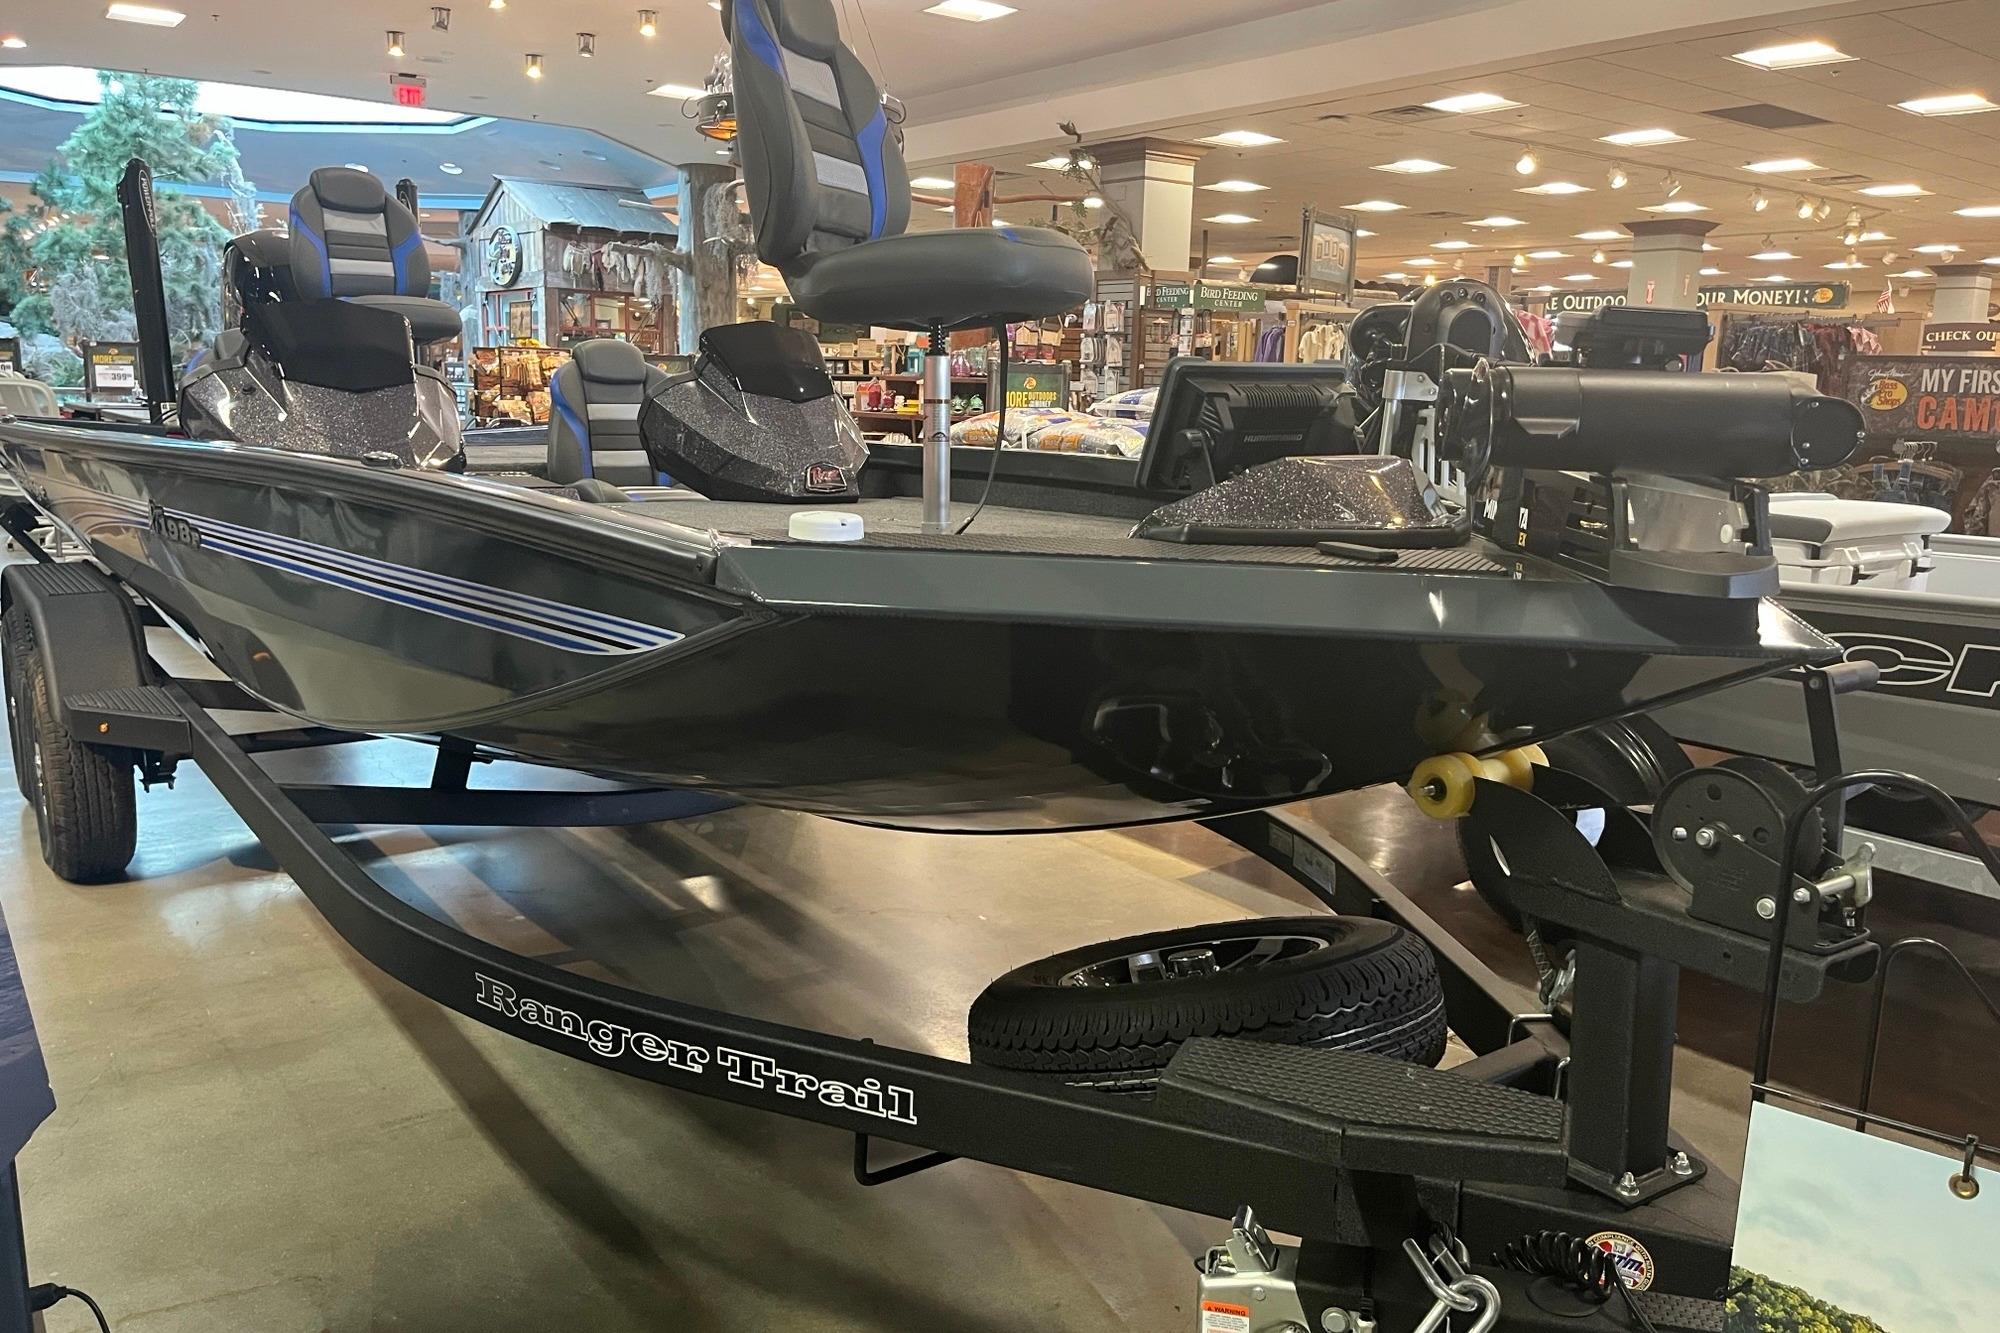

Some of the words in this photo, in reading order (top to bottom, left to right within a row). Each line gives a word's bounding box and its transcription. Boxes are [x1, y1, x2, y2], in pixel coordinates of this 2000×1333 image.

[1146, 287, 1161, 297] BD
[1162, 287, 1189, 296] FEEDING
[1201, 286, 1222, 299] BIRD
[1222, 288, 1258, 301] FEEDING
[1733, 289, 1801, 305] MONEY!
[1214, 299, 1243, 307] CENTER
[1926, 331, 1971, 342] CHECK
[1880, 380, 1898, 389] Bass
[1921, 368, 1956, 393] MY
[1880, 388, 1893, 397] Pro
[1876, 396, 1901, 408] Shops
[1917, 395, 2000, 432] CAM
[474, 972, 710, 1074] Ranger
[716, 1046, 918, 1125] Trail
[1214, 1306, 1246, 1316] WARNING
